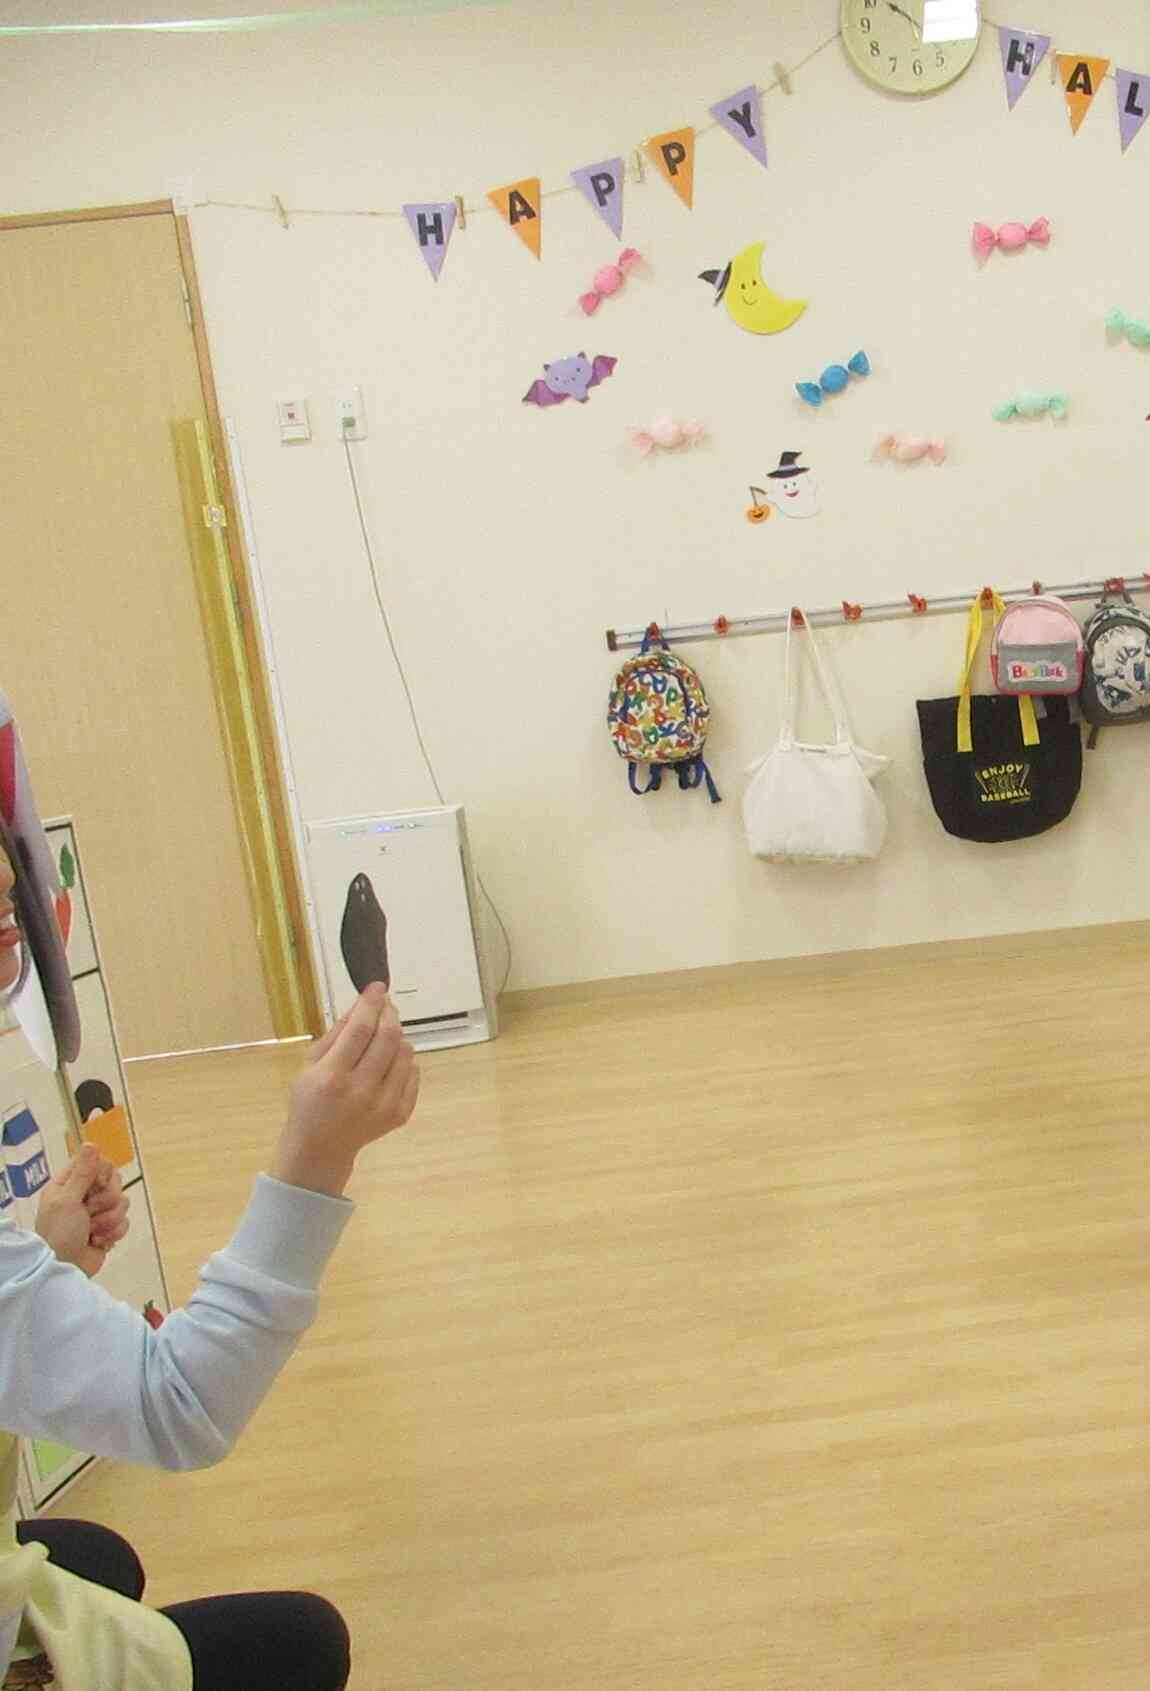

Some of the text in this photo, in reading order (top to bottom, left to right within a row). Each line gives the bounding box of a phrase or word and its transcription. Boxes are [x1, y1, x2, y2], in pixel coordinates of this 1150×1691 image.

[860, 17, 871, 34] 9
[870, 40, 881, 57] 8
[889, 57, 897, 73] 7
[912, 59, 923, 76] 6
[935, 50, 945, 68] 5
[416, 101, 756, 247] HAPPY
[982, 763, 1024, 779] ENJOY
[981, 788, 1031, 802] BASEBALL
